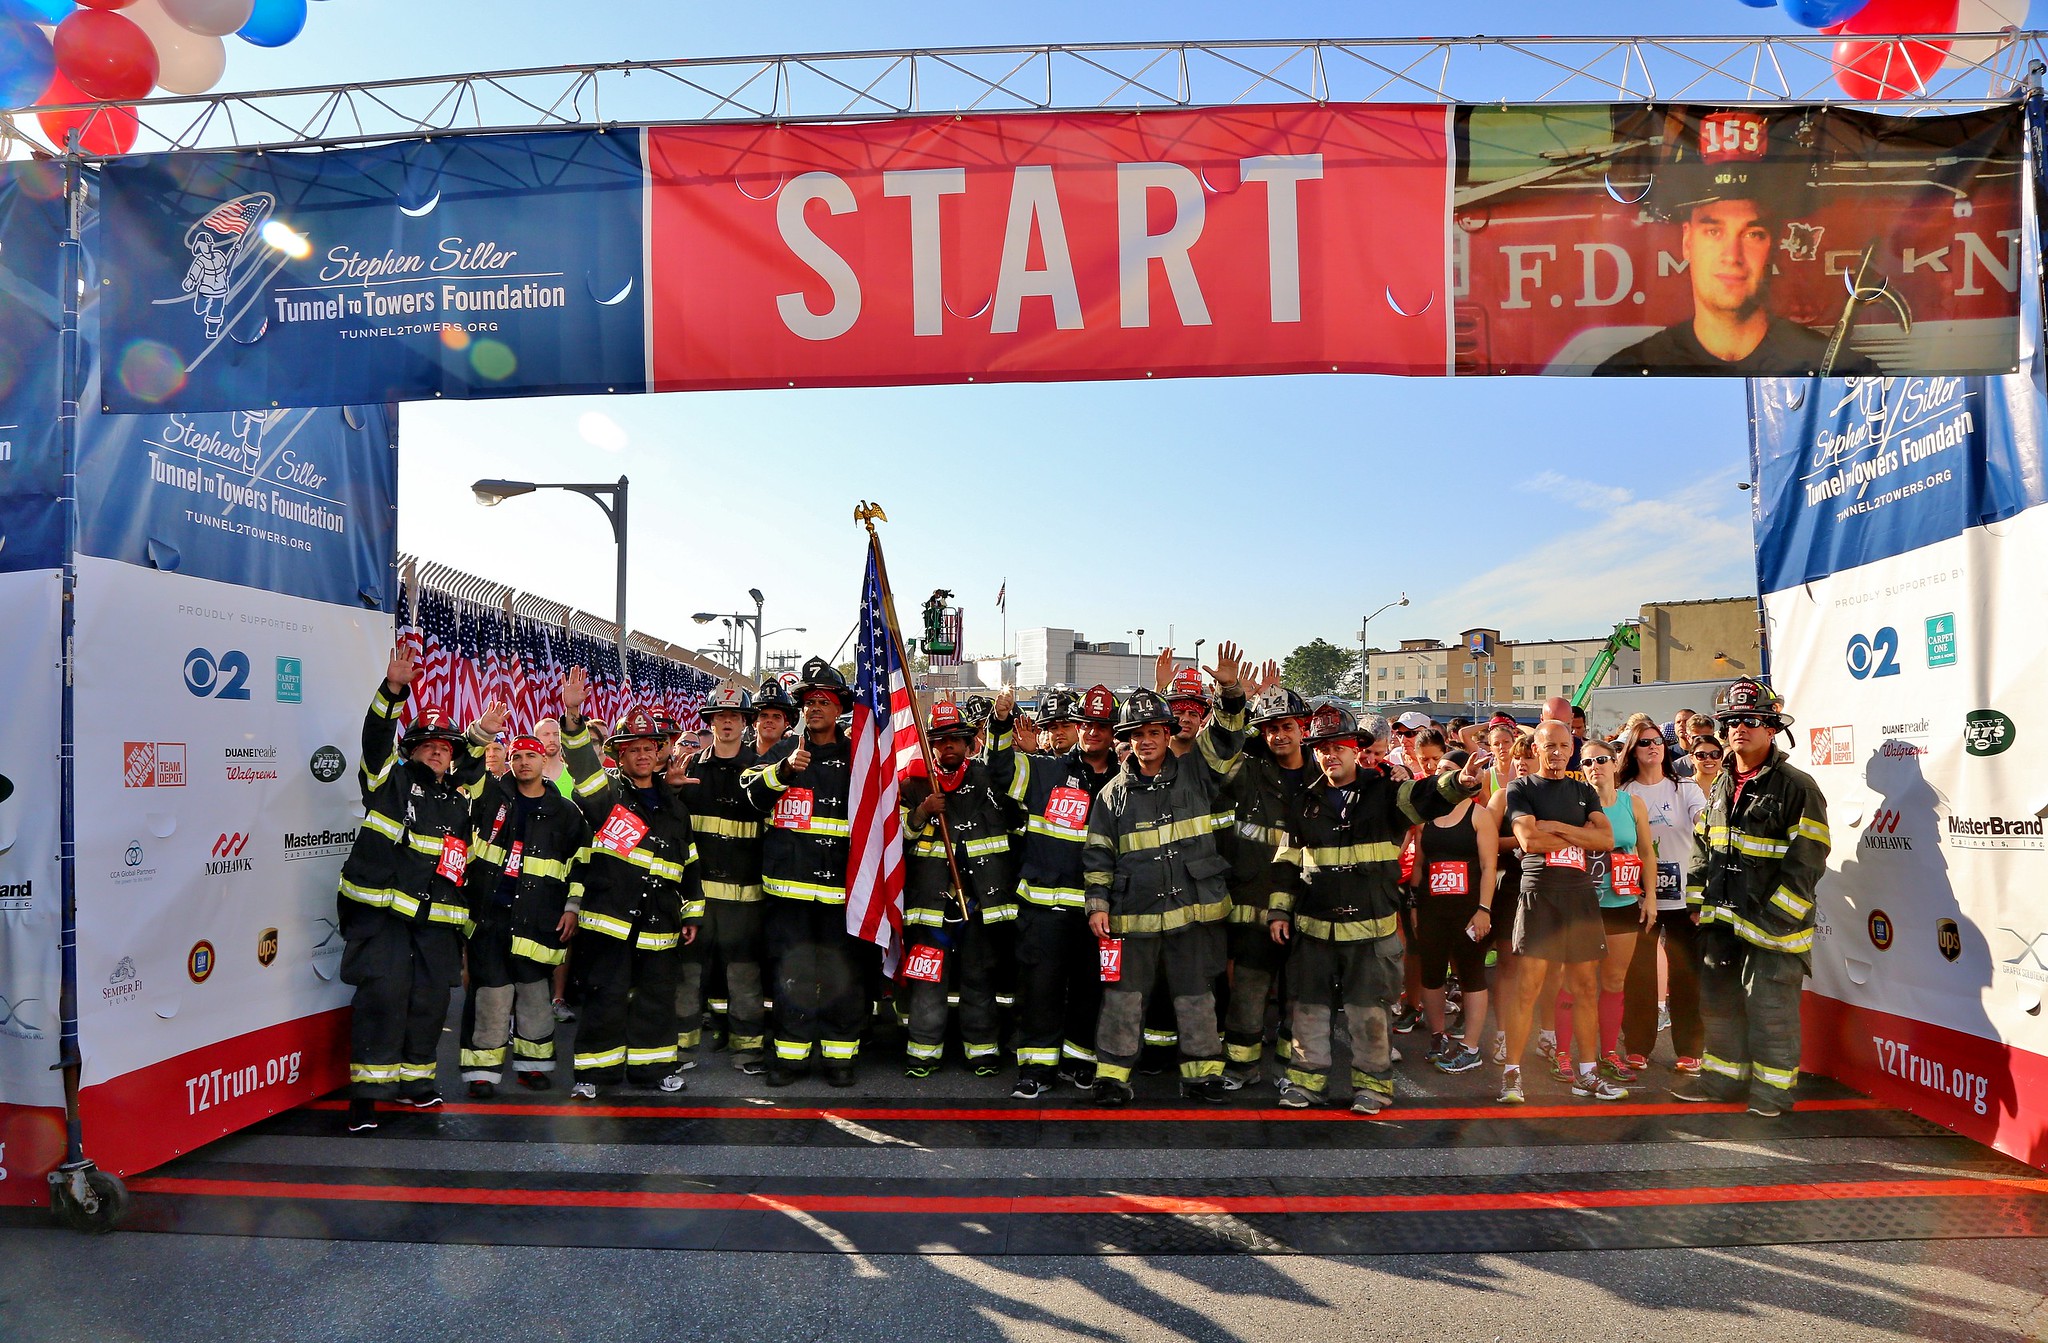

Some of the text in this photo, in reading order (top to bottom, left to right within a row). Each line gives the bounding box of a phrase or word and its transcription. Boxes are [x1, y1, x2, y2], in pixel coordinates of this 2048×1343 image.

[1705, 120, 1759, 153] 153
[775, 153, 1324, 342] START
[319, 237, 517, 289] Stephen Siller
[1500, 242, 1645, 309] F.D.
[275, 282, 565, 323] Tunnel TO Towers Foundation
[339, 322, 498, 340] TUNNEL2TOWERS.ORG
[1902, 377, 1961, 423] Siller
[162, 412, 327, 490] Stephen Siller
[148, 451, 344, 533] Tunnel TO Towers Foundation
[185, 509, 312, 552] TUNNEL2TOWERS.ORG
[1835, 590, 1880, 609] PROUDLY
[1885, 572, 1947, 597] SUPPORTED
[178, 604, 314, 633] PROUDLY SUPPORTED BY
[1928, 632, 1953, 645] CARPET
[1933, 643, 1949, 654] ONE
[277, 673, 300, 683] CARPET
[809, 666, 821, 678] 7
[281, 682, 295, 691] ONE
[724, 689, 735, 700] 7
[765, 686, 778, 697] 11
[1047, 698, 1058, 711] 9
[1092, 696, 1104, 711] 4
[1136, 699, 1154, 713] 14
[1737, 693, 1748, 704] 9
[937, 706, 954, 714] 1087
[427, 713, 440, 726] 7
[634, 714, 647, 728] 4
[1834, 741, 1850, 752] TEAM
[1883, 742, 1929, 761] Walgreens
[313, 757, 340, 769] JETS
[1834, 751, 1852, 762] DEPOT
[160, 761, 180, 772] TEAM
[160, 773, 183, 783] DEPOT
[226, 766, 277, 784] Walgreens
[777, 799, 811, 816] 1090
[1050, 798, 1088, 816] 1075
[606, 816, 641, 846] 1072
[1948, 815, 2044, 836] MasterBrand
[284, 828, 356, 849] MasterBrand
[1865, 835, 1912, 851] MOHAWK
[205, 857, 252, 876] MOHAWK
[1613, 865, 1640, 881] 1670
[1431, 872, 1464, 888] 2291
[260, 939, 277, 961] ups
[1938, 931, 1960, 955] ups
[198, 955, 206, 965] GM
[908, 955, 941, 975] 1087
[1100, 950, 1118, 966] 67
[103, 983, 133, 999] SEMPER
[110, 994, 136, 1006] FUND
[185, 1050, 302, 1116] T2Trun.org
[1873, 1036, 1989, 1115] T2Trun.org
